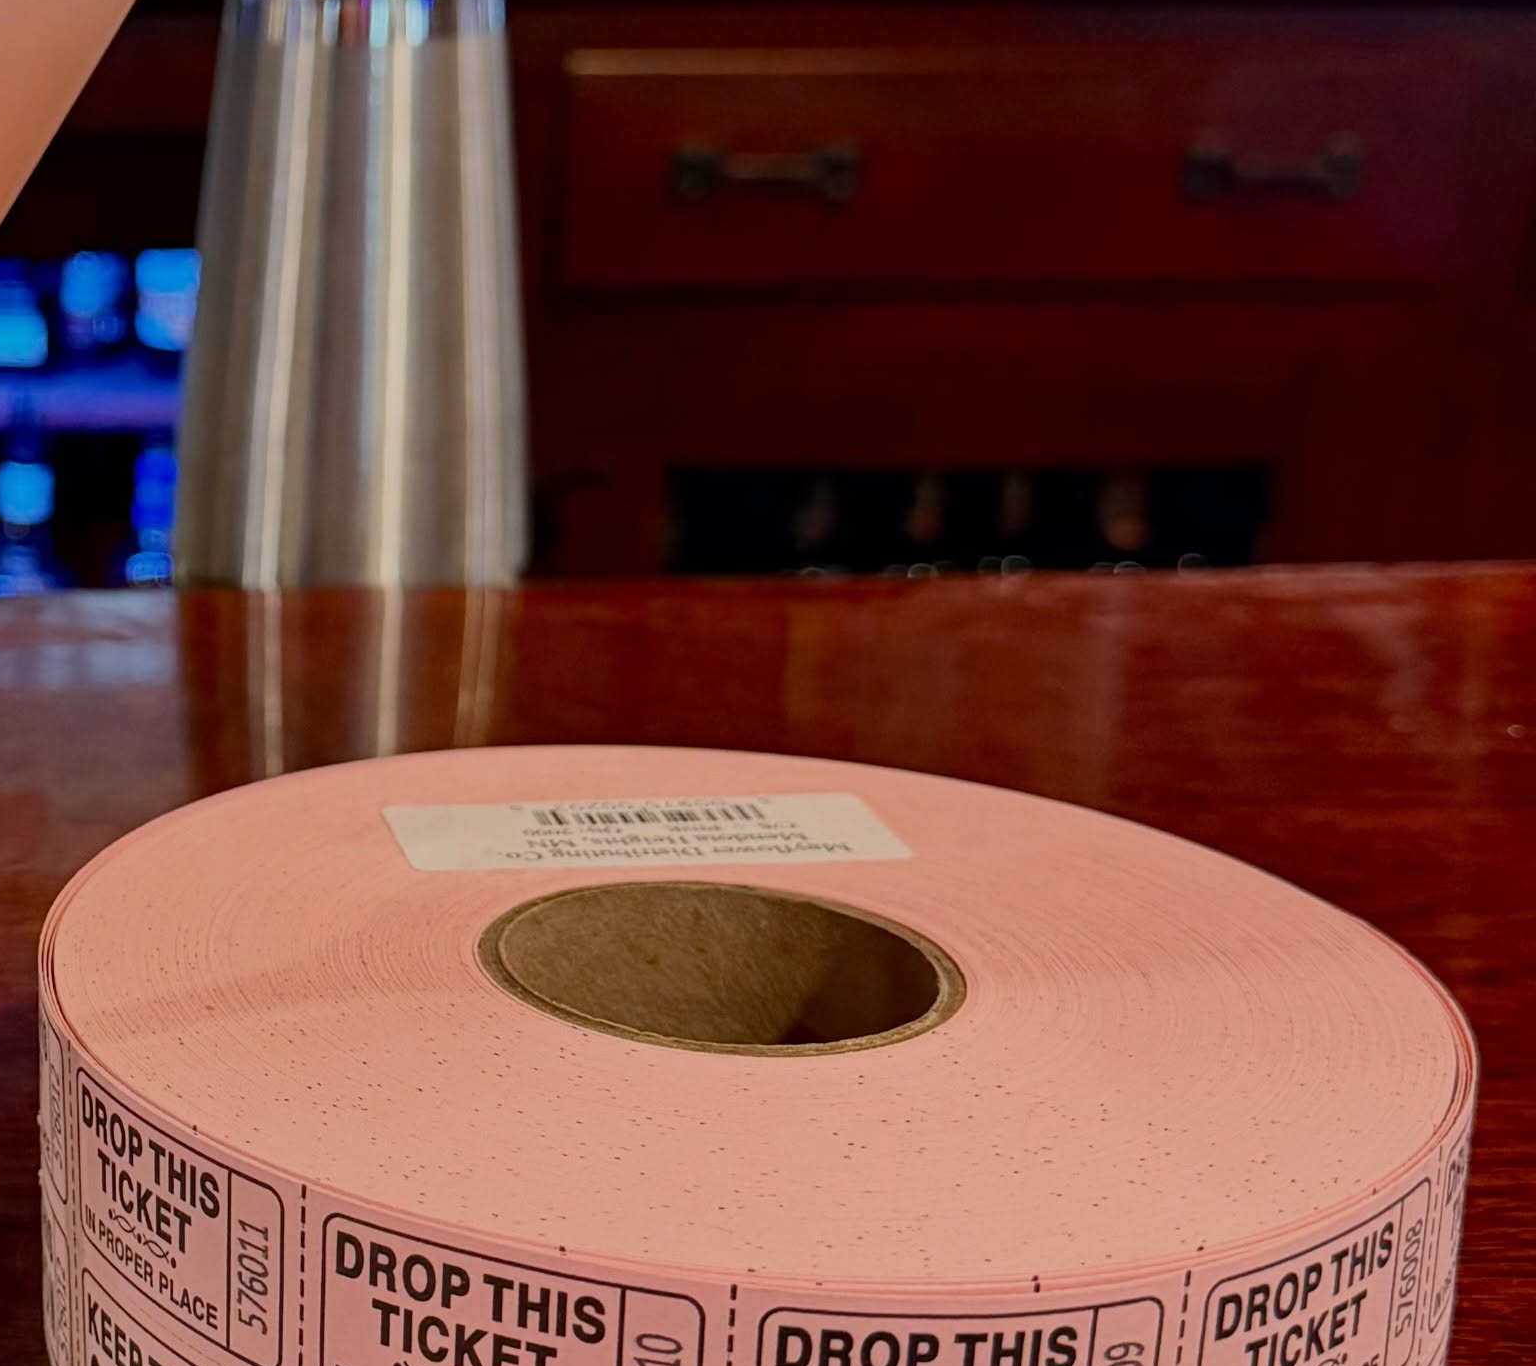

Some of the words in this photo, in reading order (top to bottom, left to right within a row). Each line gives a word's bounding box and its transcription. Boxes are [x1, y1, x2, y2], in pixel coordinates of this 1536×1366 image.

[498, 848, 544, 861] Co.
[526, 838, 576, 849] MN
[552, 844, 704, 859] Distributing
[713, 839, 854, 854] Mayflower
[81, 1083, 143, 1167] DROP
[149, 1139, 220, 1219] THIS
[97, 1148, 191, 1254] TICKET
[85, 1203, 96, 1234] IN
[99, 1219, 154, 1287] PROPER
[159, 1272, 218, 1329] PLACE
[237, 1219, 269, 1335] 576011
[335, 1230, 471, 1309] DROP
[482, 1273, 606, 1345] THIS
[1214, 1262, 1323, 1342] DROP
[1330, 1222, 1394, 1295] THIS
[1395, 1219, 1423, 1338] 576008
